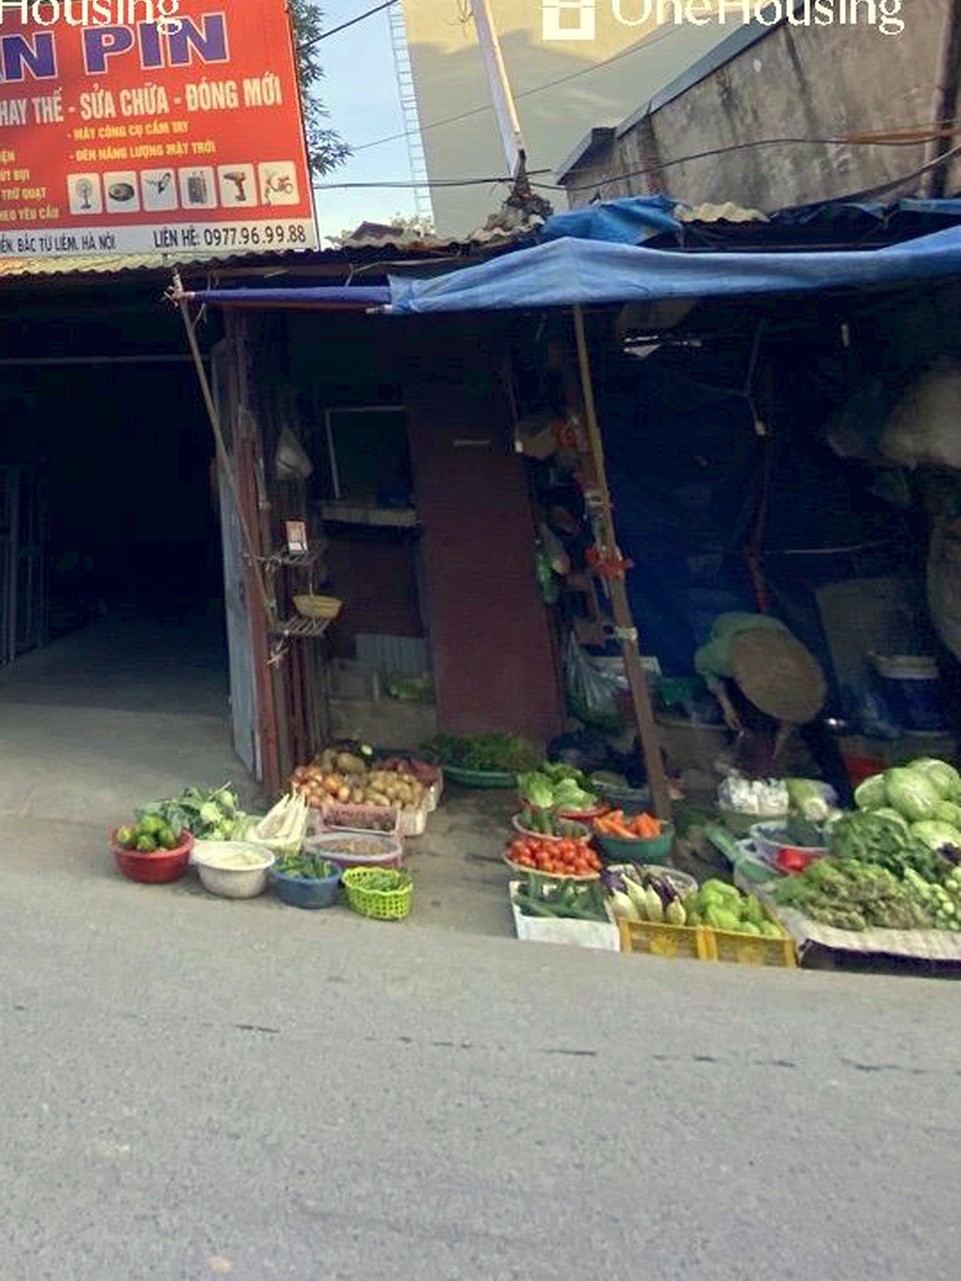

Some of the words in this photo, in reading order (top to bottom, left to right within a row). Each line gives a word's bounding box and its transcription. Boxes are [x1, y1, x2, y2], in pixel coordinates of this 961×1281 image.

[82, 12, 231, 76] PIN
[33, 87, 64, 123] THẾ
[79, 83, 115, 120] SỬA
[120, 81, 170, 116] CHỮA
[185, 76, 239, 112] ĐÓNG
[243, 72, 283, 107] MỚI
[153, 226, 179, 248] LIÊN
[204, 224, 307, 247] 0977.96.99.88
